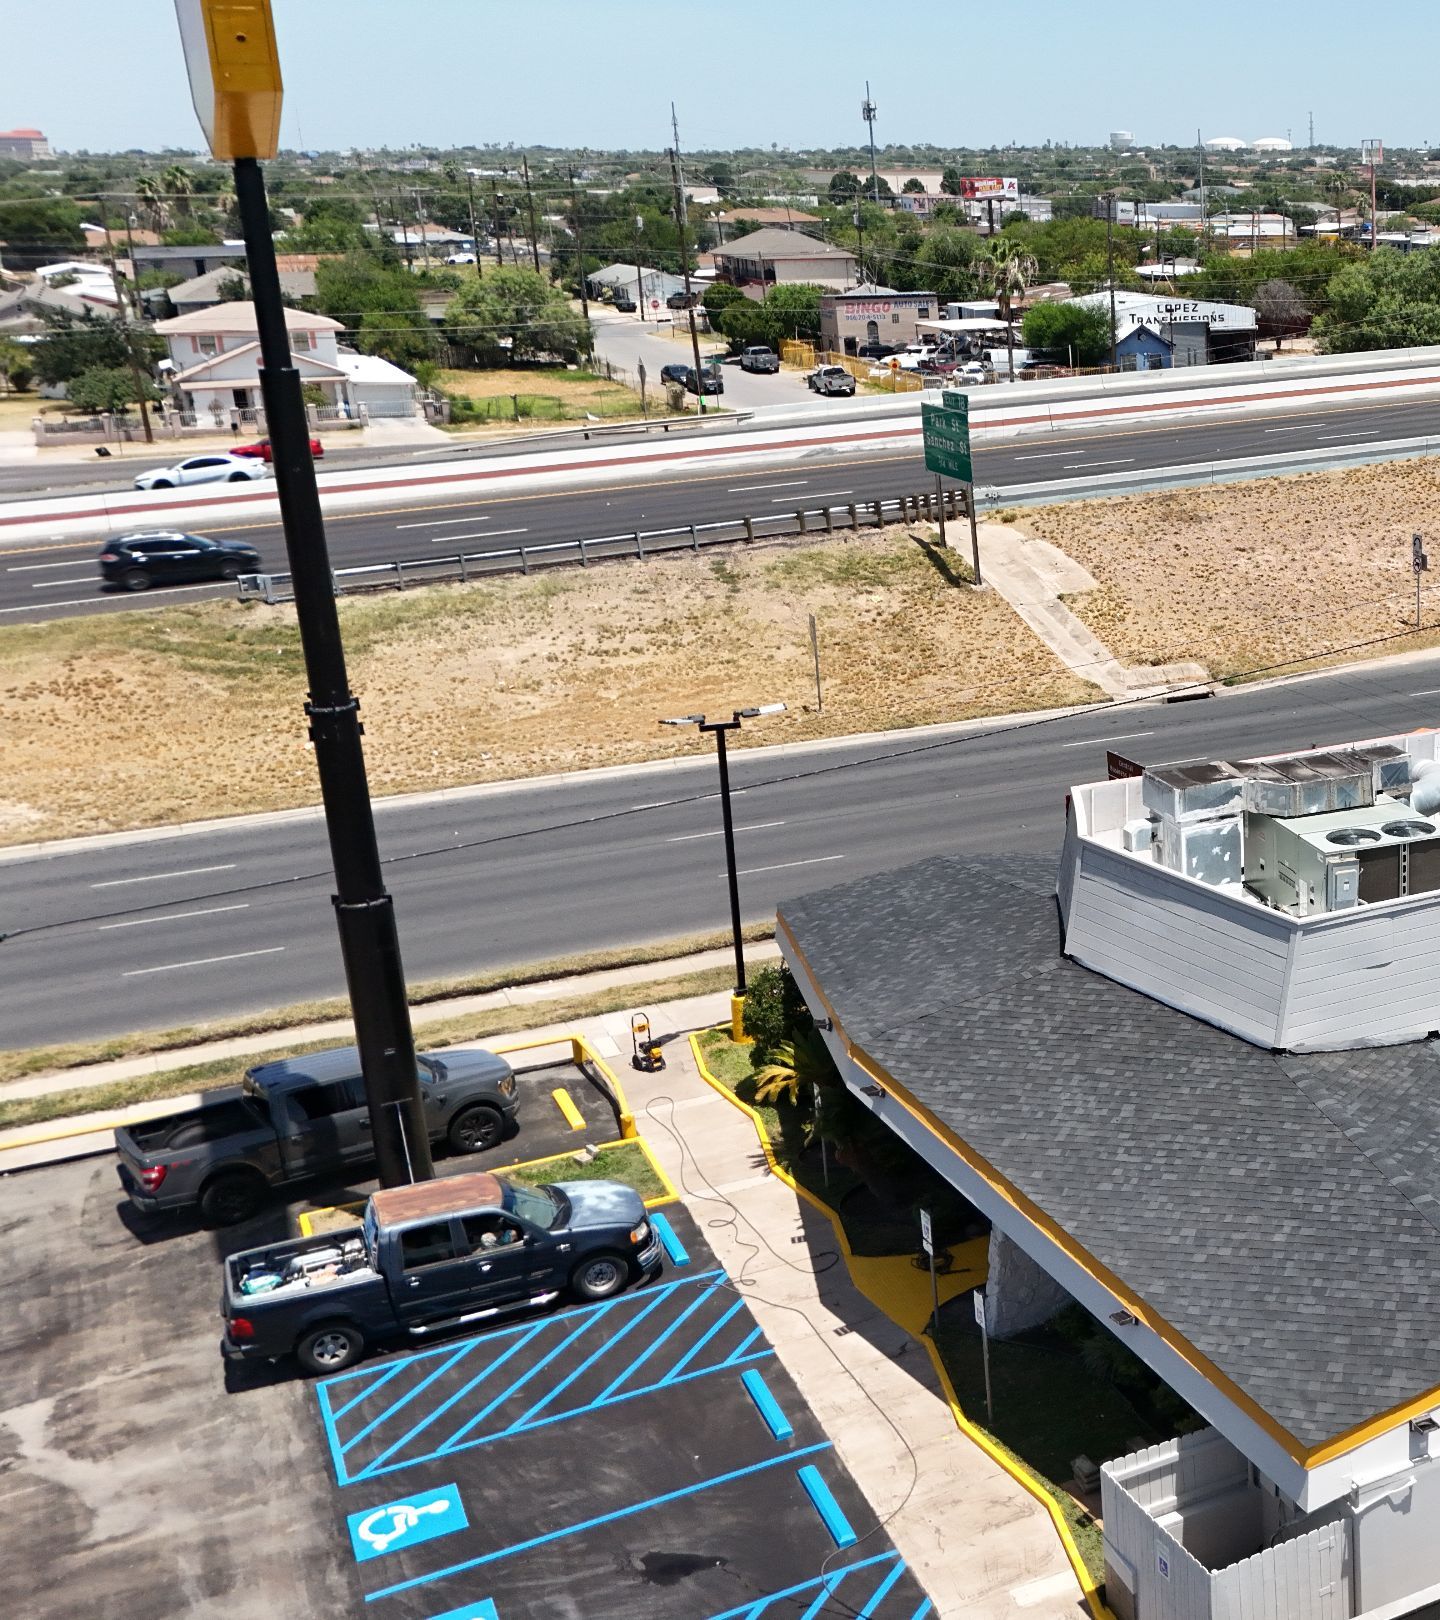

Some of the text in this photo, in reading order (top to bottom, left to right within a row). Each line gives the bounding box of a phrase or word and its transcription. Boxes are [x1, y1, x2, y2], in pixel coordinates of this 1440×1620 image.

[845, 302, 891, 314] BINGO
[893, 299, 934, 309] AUTO SALES
[1157, 304, 1198, 313] LOPEZ
[930, 413, 960, 433] Park St
[926, 432, 968, 455] Sanchez St
